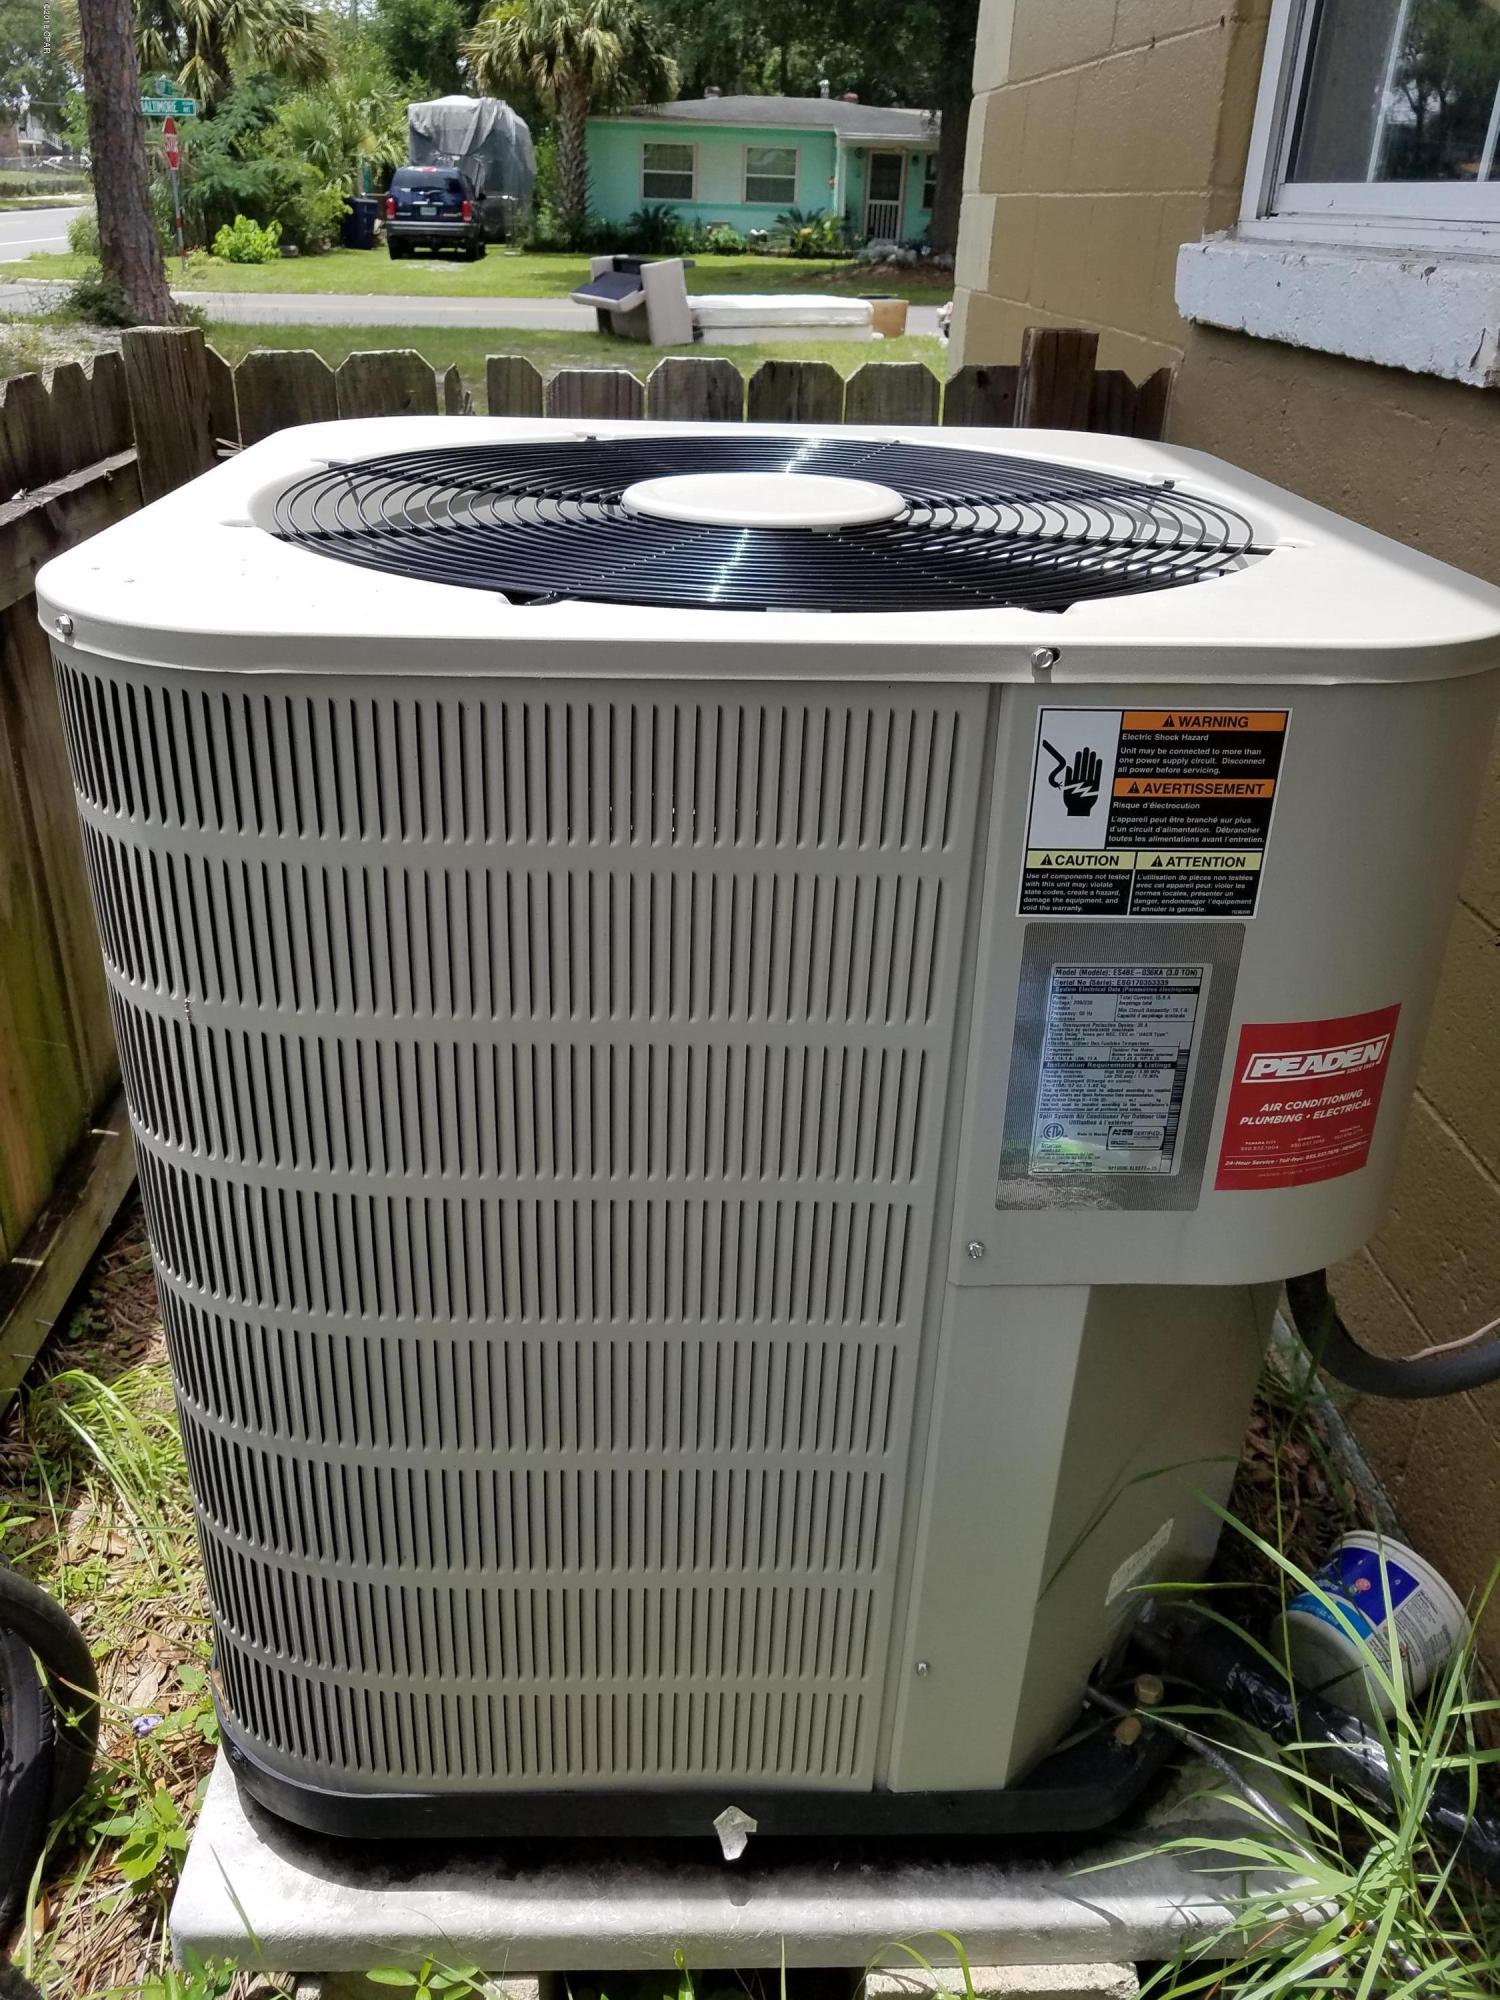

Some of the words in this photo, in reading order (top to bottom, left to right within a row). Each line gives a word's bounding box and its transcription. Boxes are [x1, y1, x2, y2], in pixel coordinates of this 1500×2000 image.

[164, 133, 179, 153] STOP
[1179, 716, 1248, 728] WARNING
[1143, 783, 1265, 794] AVERTISSEMENT
[1055, 855, 1119, 866] CAUTION
[1166, 857, 1246, 867] ATTENTION
[1250, 1040, 1384, 1078] PEADEN
[1260, 1103, 1282, 1112] AIR
[1285, 1089, 1363, 1110] CONDITIONING
[1240, 1114, 1303, 1125] PLUMBING
[1312, 1098, 1372, 1120] ELECTRICAL
